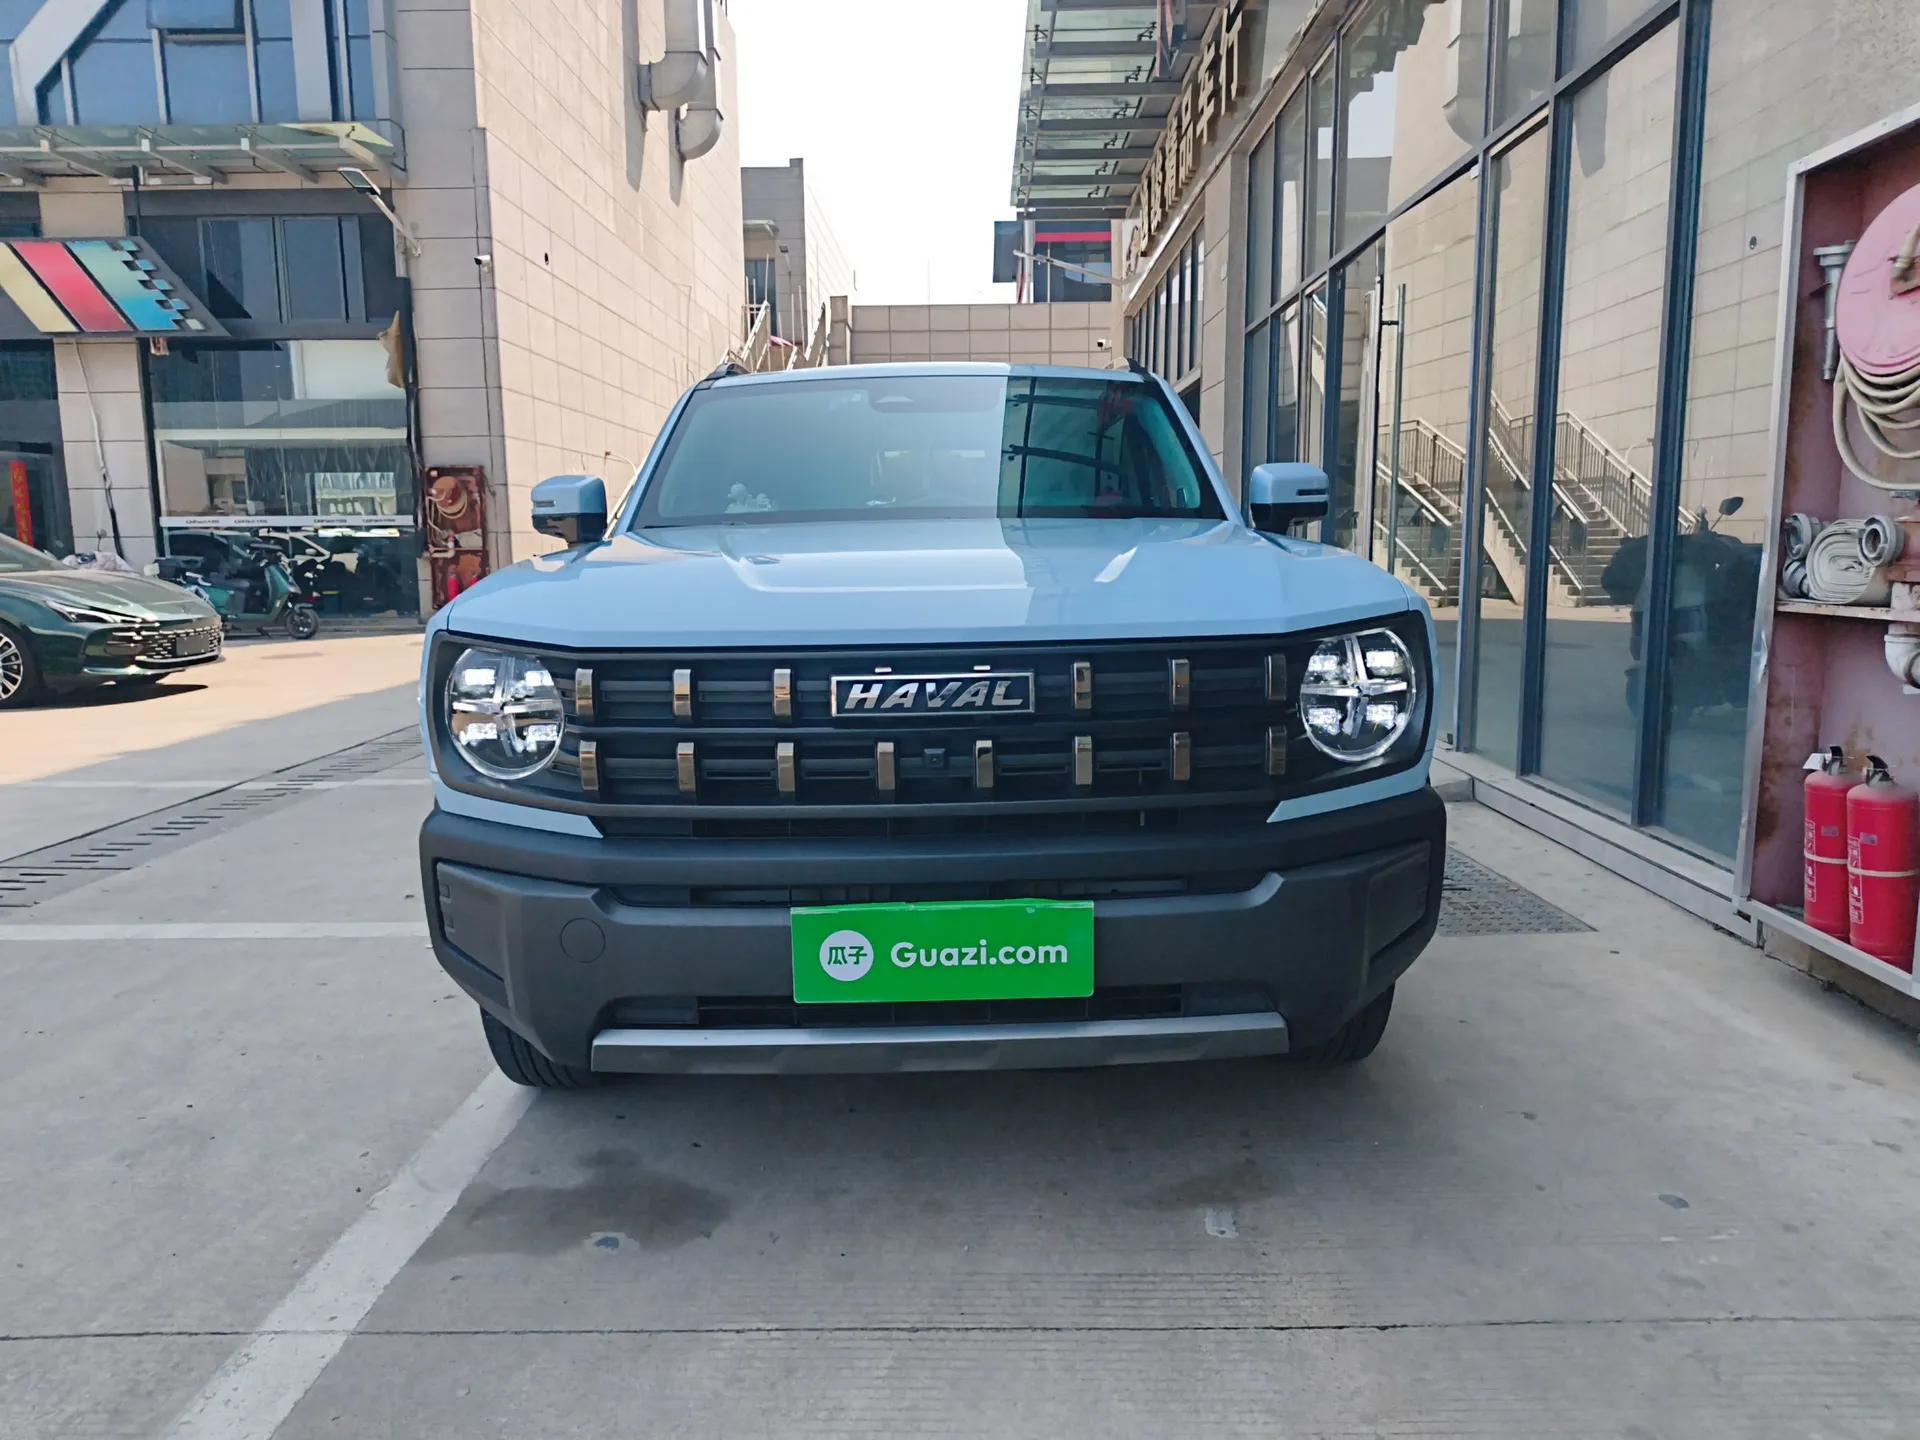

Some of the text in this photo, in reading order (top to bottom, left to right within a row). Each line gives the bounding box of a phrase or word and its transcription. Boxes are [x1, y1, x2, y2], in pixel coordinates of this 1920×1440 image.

[844, 680, 1024, 710] HAVAL
[827, 945, 868, 965] 瓜子
[890, 940, 1068, 968] Guazi.com
